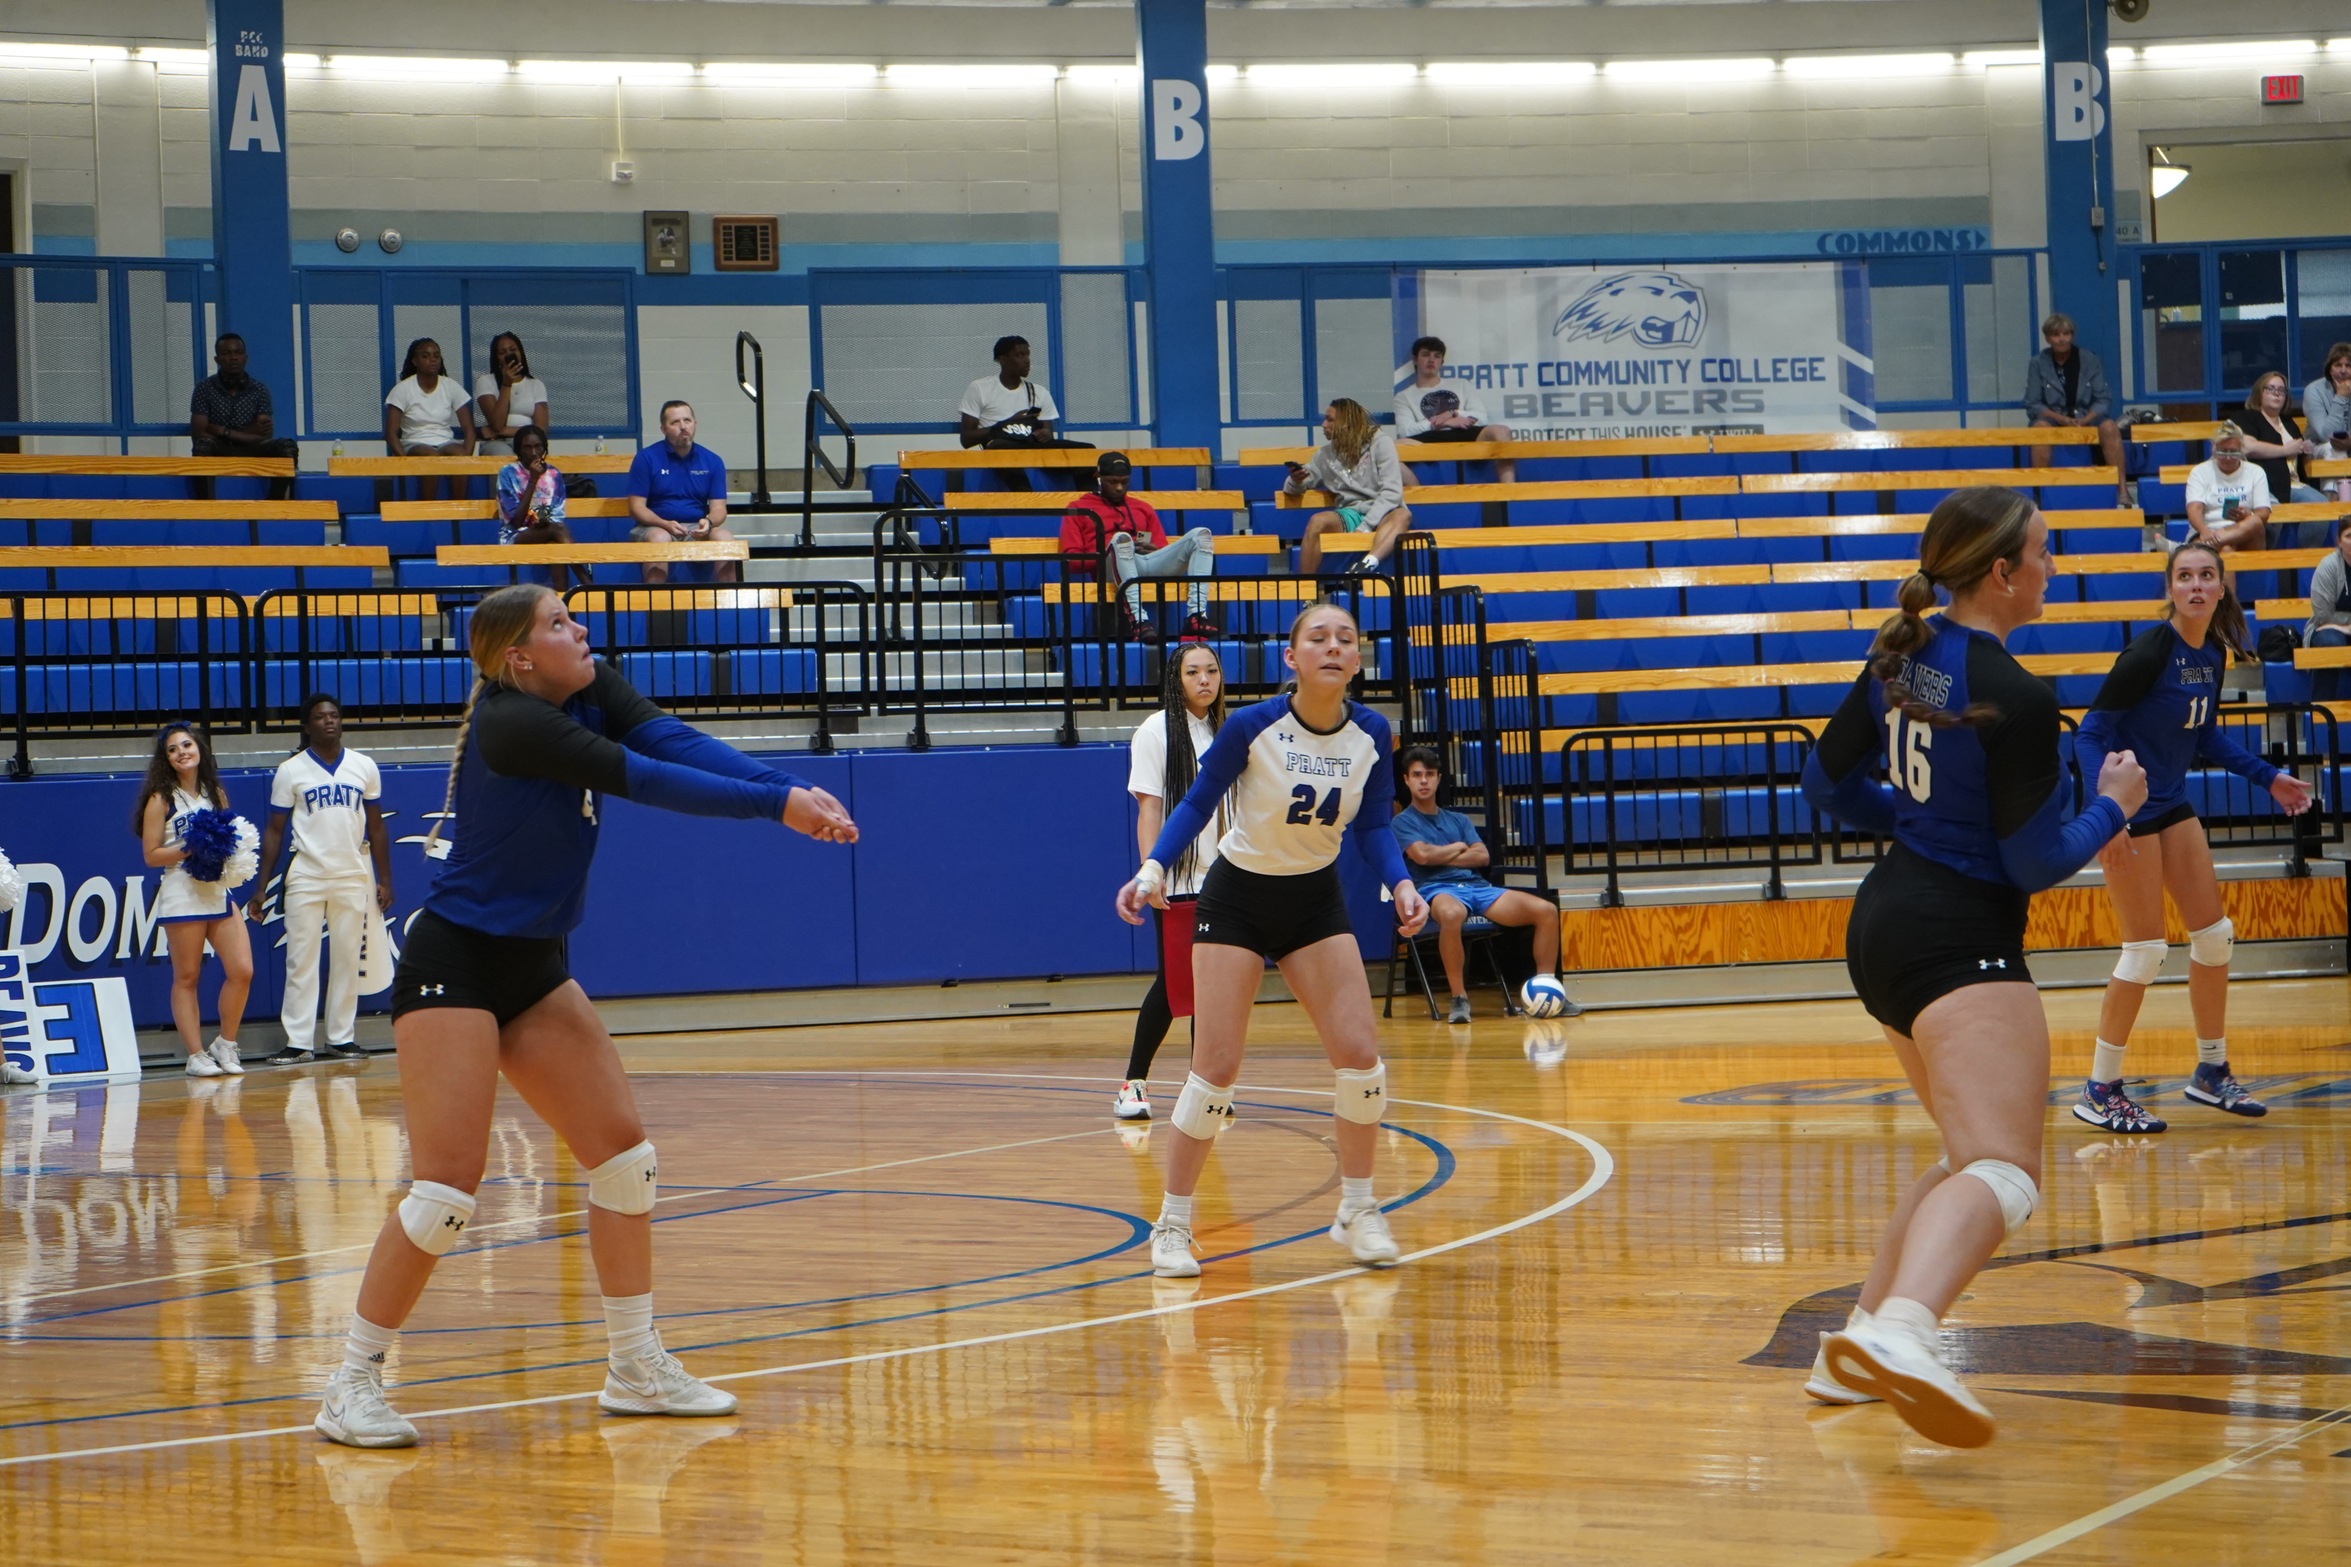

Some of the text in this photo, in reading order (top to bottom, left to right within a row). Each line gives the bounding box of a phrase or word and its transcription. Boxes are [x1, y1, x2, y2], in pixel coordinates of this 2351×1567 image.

[235, 44, 269, 58] BAND
[2053, 62, 2105, 141] B
[2266, 75, 2299, 101] EXIT
[229, 64, 281, 152] A
[1152, 79, 1205, 160] B
[1816, 230, 1971, 254] COMMONS
[1439, 356, 1826, 390] PRATT COMMUNITY COLLEGE
[1503, 389, 1765, 419] BEAVERS
[1896, 655, 1953, 709] EAVERS
[2181, 667, 2214, 685] PRATT
[2183, 696, 2208, 729] 11
[1286, 752, 1351, 777] PRATT
[1885, 706, 1932, 804] 16
[302, 783, 364, 816] PRATT
[1286, 783, 1341, 826] 24
